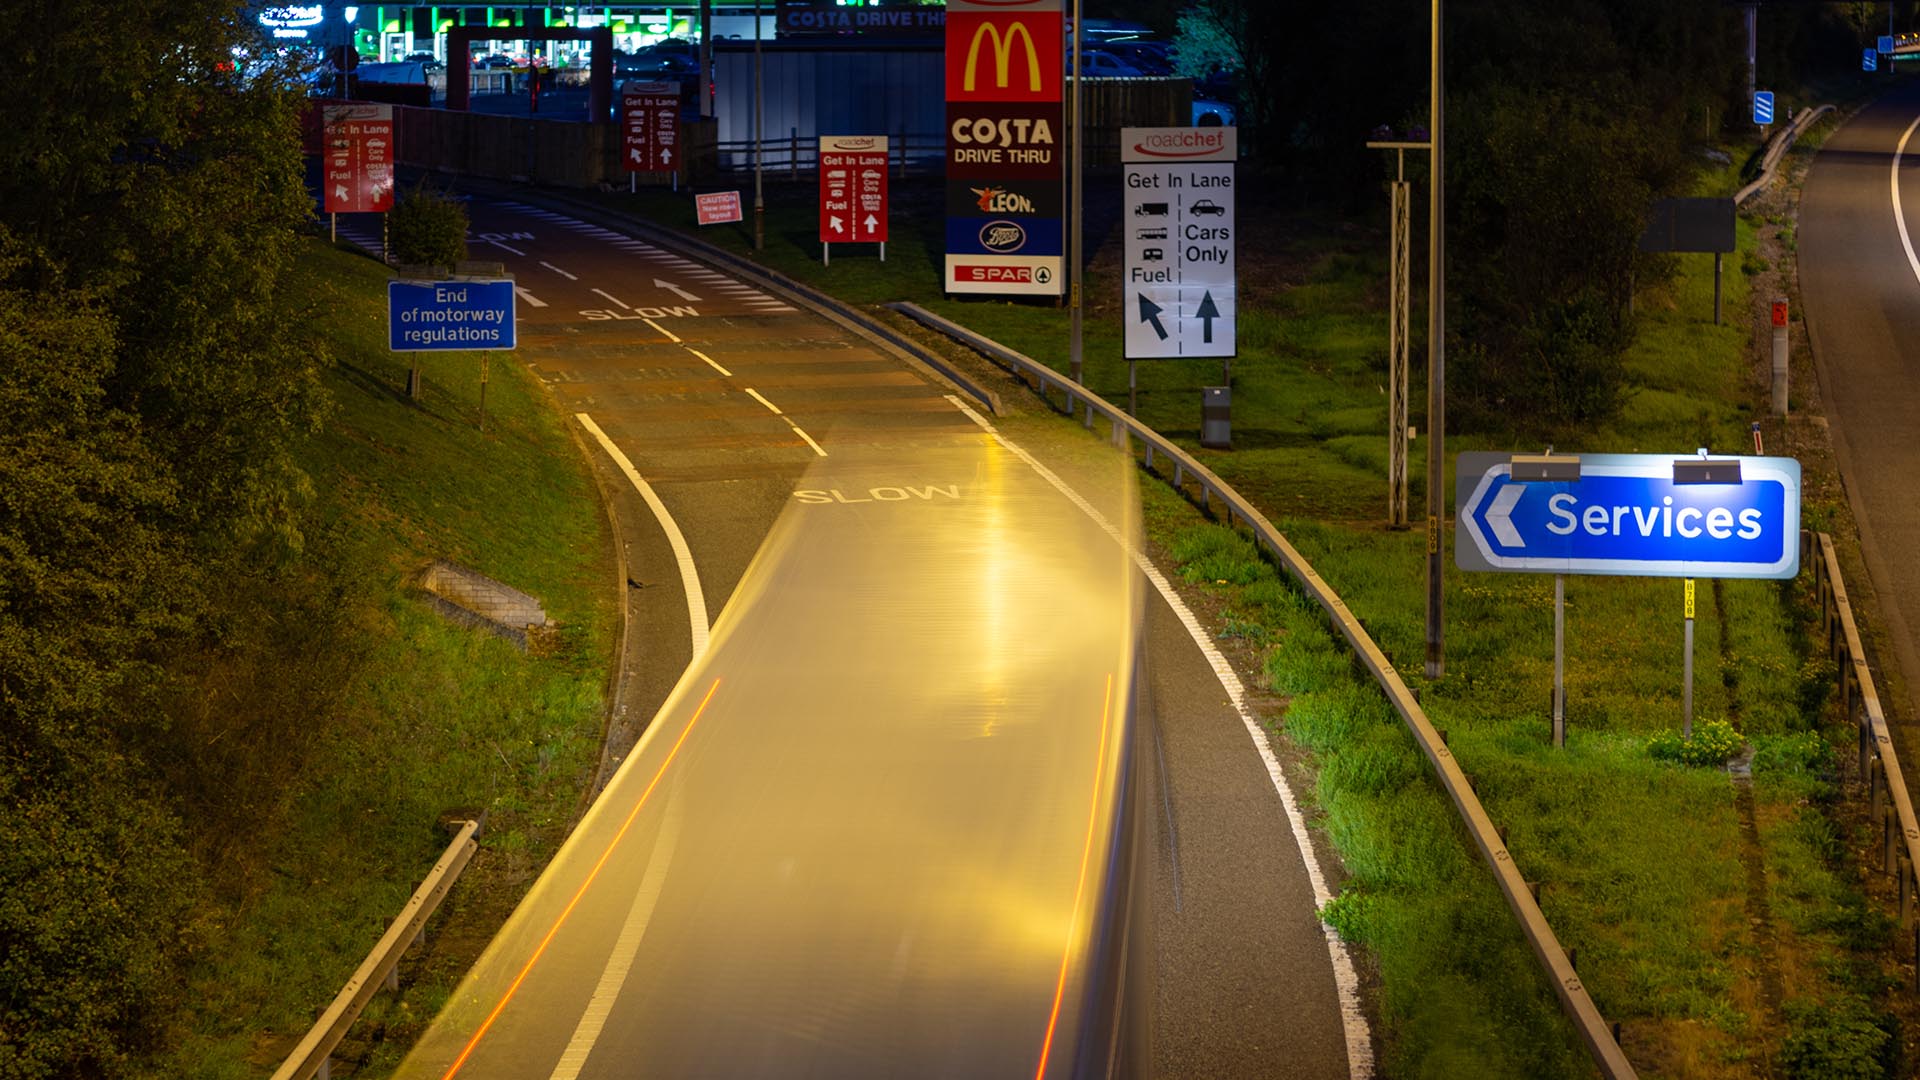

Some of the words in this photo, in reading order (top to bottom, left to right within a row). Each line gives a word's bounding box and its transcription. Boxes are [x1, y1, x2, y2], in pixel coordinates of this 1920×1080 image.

[787, 11, 849, 28] COSTA
[856, 12, 912, 26] DRIVE
[625, 97, 641, 106] Get
[644, 98, 653, 106] In
[656, 98, 678, 106] Lane
[350, 125, 359, 134] In
[363, 125, 389, 134] Lane
[951, 118, 1054, 148] COSTA
[627, 135, 646, 144] Fuel
[1145, 131, 1224, 147] roadchef
[823, 155, 842, 165] Get
[846, 155, 856, 165] In
[859, 156, 885, 165] Lane
[954, 148, 1002, 163] DRIVE
[1007, 149, 1051, 163] THRU
[330, 171, 352, 179] Fuel
[1127, 172, 1160, 188] Get
[1168, 173, 1183, 188] In
[1191, 172, 1232, 188] Lane
[701, 194, 736, 203] CAUTION
[826, 200, 847, 210] Fuel
[985, 227, 1020, 246] Boots
[1185, 224, 1230, 240] Cars
[1186, 246, 1228, 264] Only
[971, 268, 1031, 280] SPAR
[1132, 267, 1172, 283] Fuel
[436, 288, 467, 303] End
[401, 307, 419, 322] of
[420, 307, 505, 324] motorway
[578, 306, 700, 320] SLOW
[404, 326, 500, 345] regulations
[793, 484, 961, 504] SLOW
[1545, 493, 1763, 541] Services
